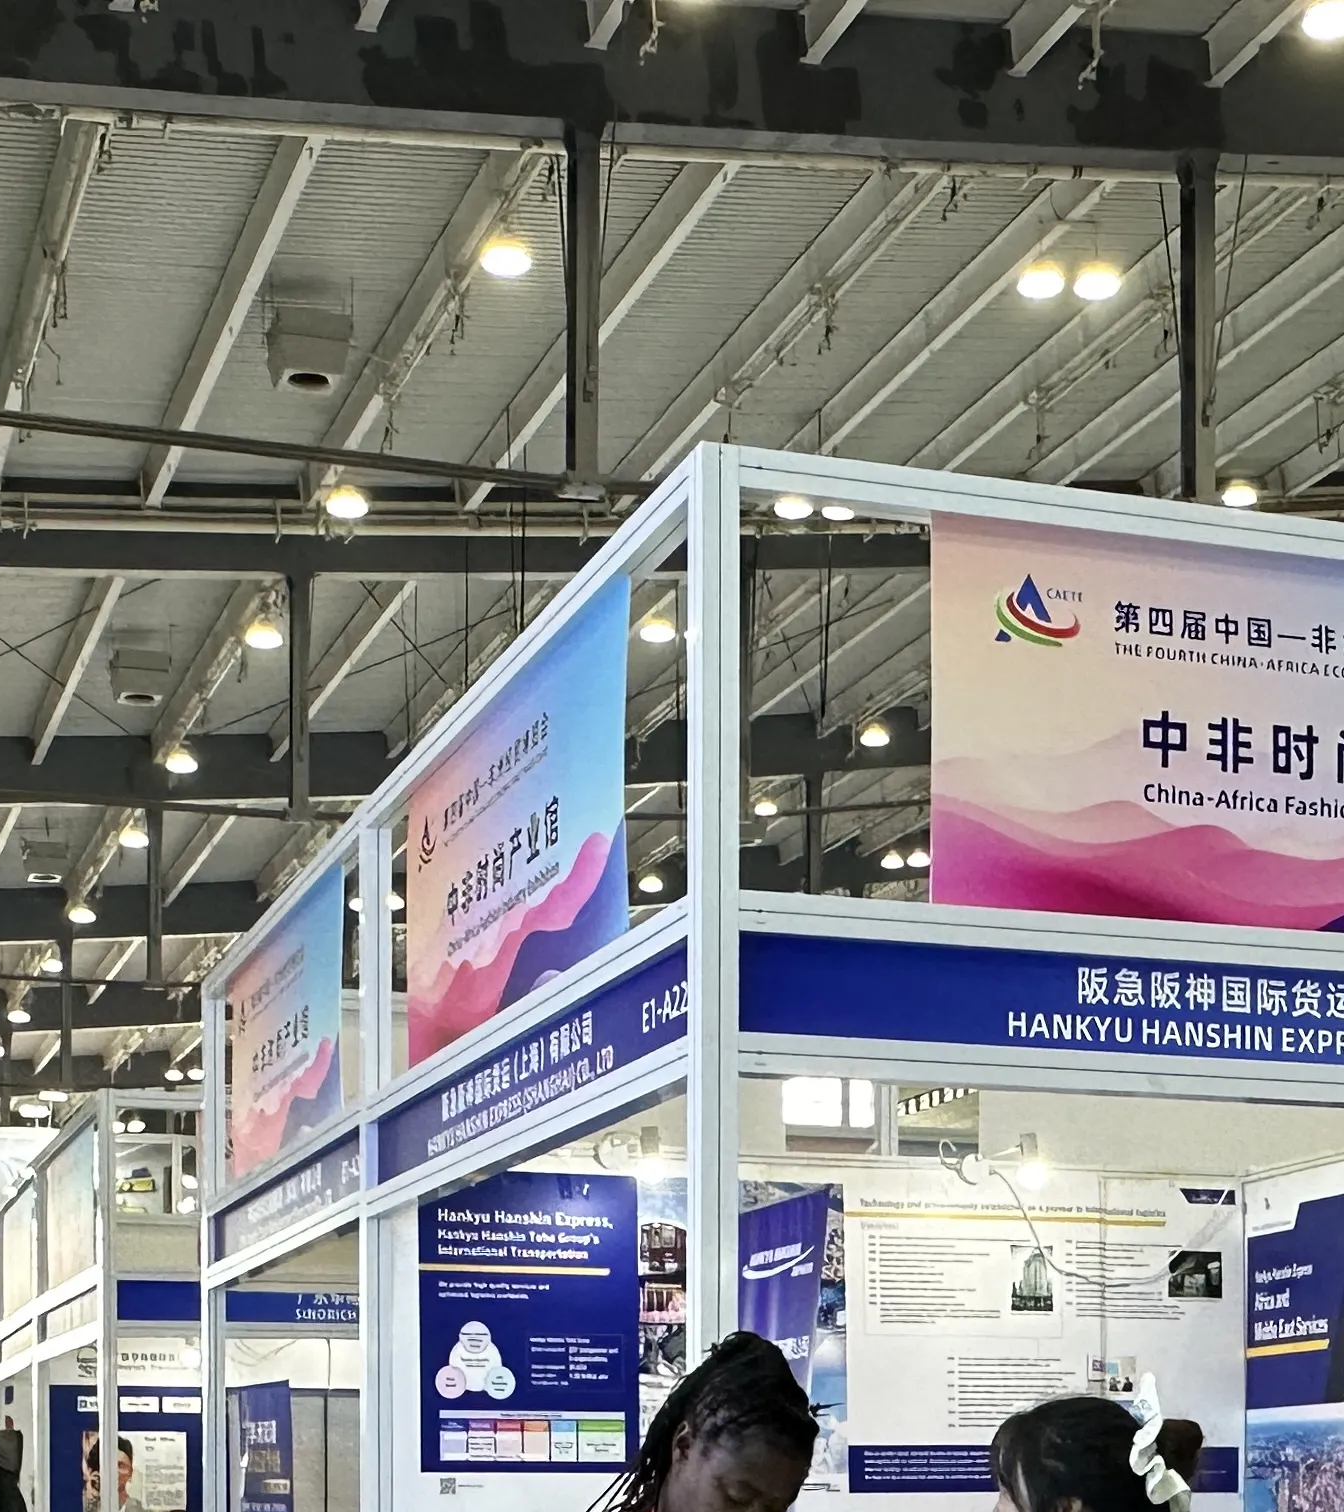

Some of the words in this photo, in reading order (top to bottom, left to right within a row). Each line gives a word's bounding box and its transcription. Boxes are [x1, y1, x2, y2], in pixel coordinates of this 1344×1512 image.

[1114, 641, 1142, 658] THE
[1146, 646, 1207, 664] FOURTH
[1143, 782, 1279, 814] China-Africa
[1006, 1010, 1134, 1047] HANKYU
[1142, 1017, 1274, 1053] HANSHIN
[437, 1208, 491, 1225] Hankyu
[494, 1210, 552, 1226] Hanshin
[437, 1244, 508, 1257] International
[510, 1246, 590, 1260] Transportation
